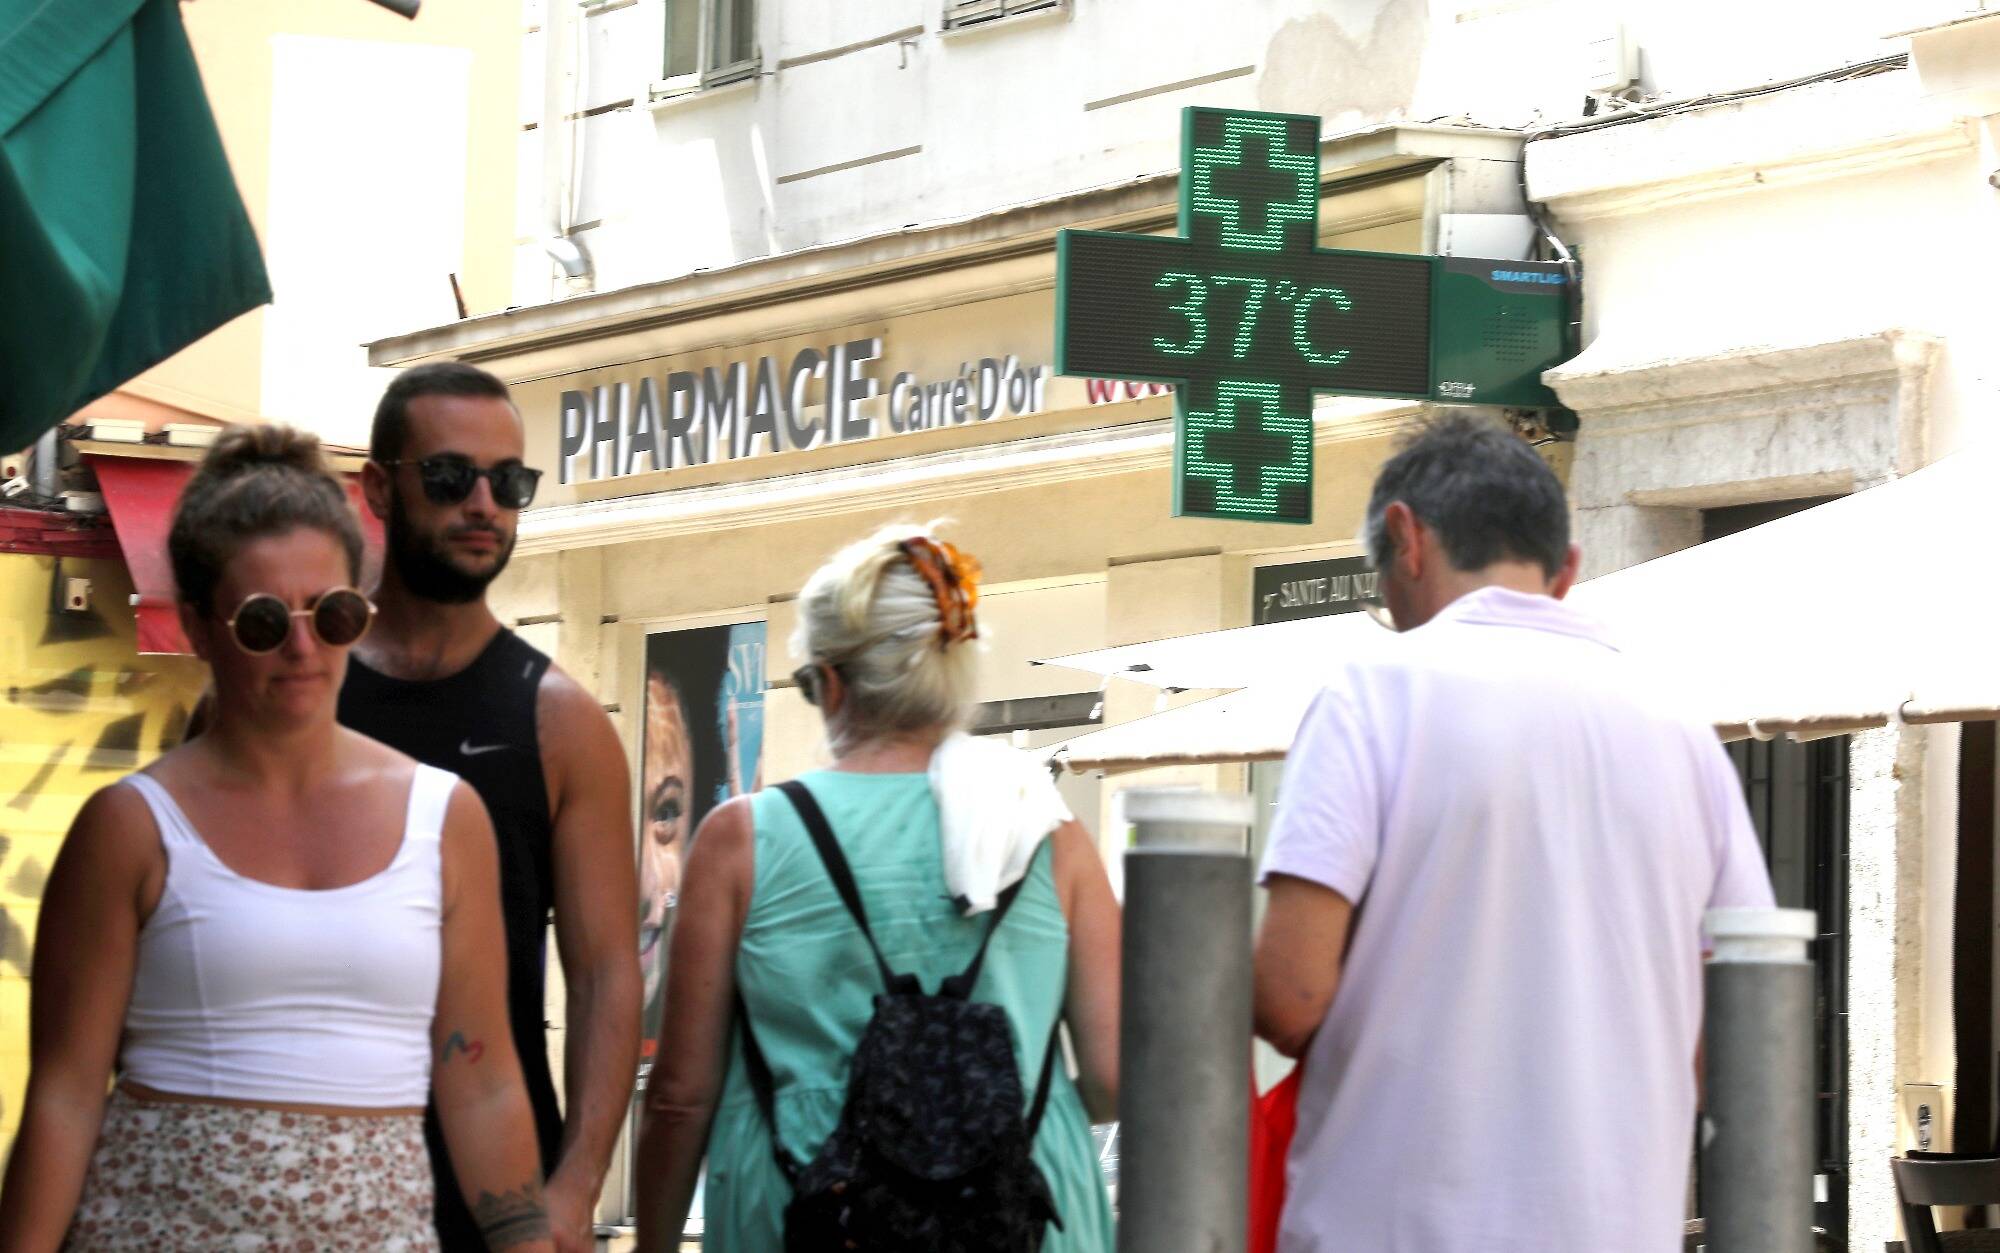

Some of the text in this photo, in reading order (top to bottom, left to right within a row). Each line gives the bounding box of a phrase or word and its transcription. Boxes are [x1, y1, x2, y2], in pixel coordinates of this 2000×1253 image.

[558, 337, 1046, 485] PHARMACIE Carré D'or
